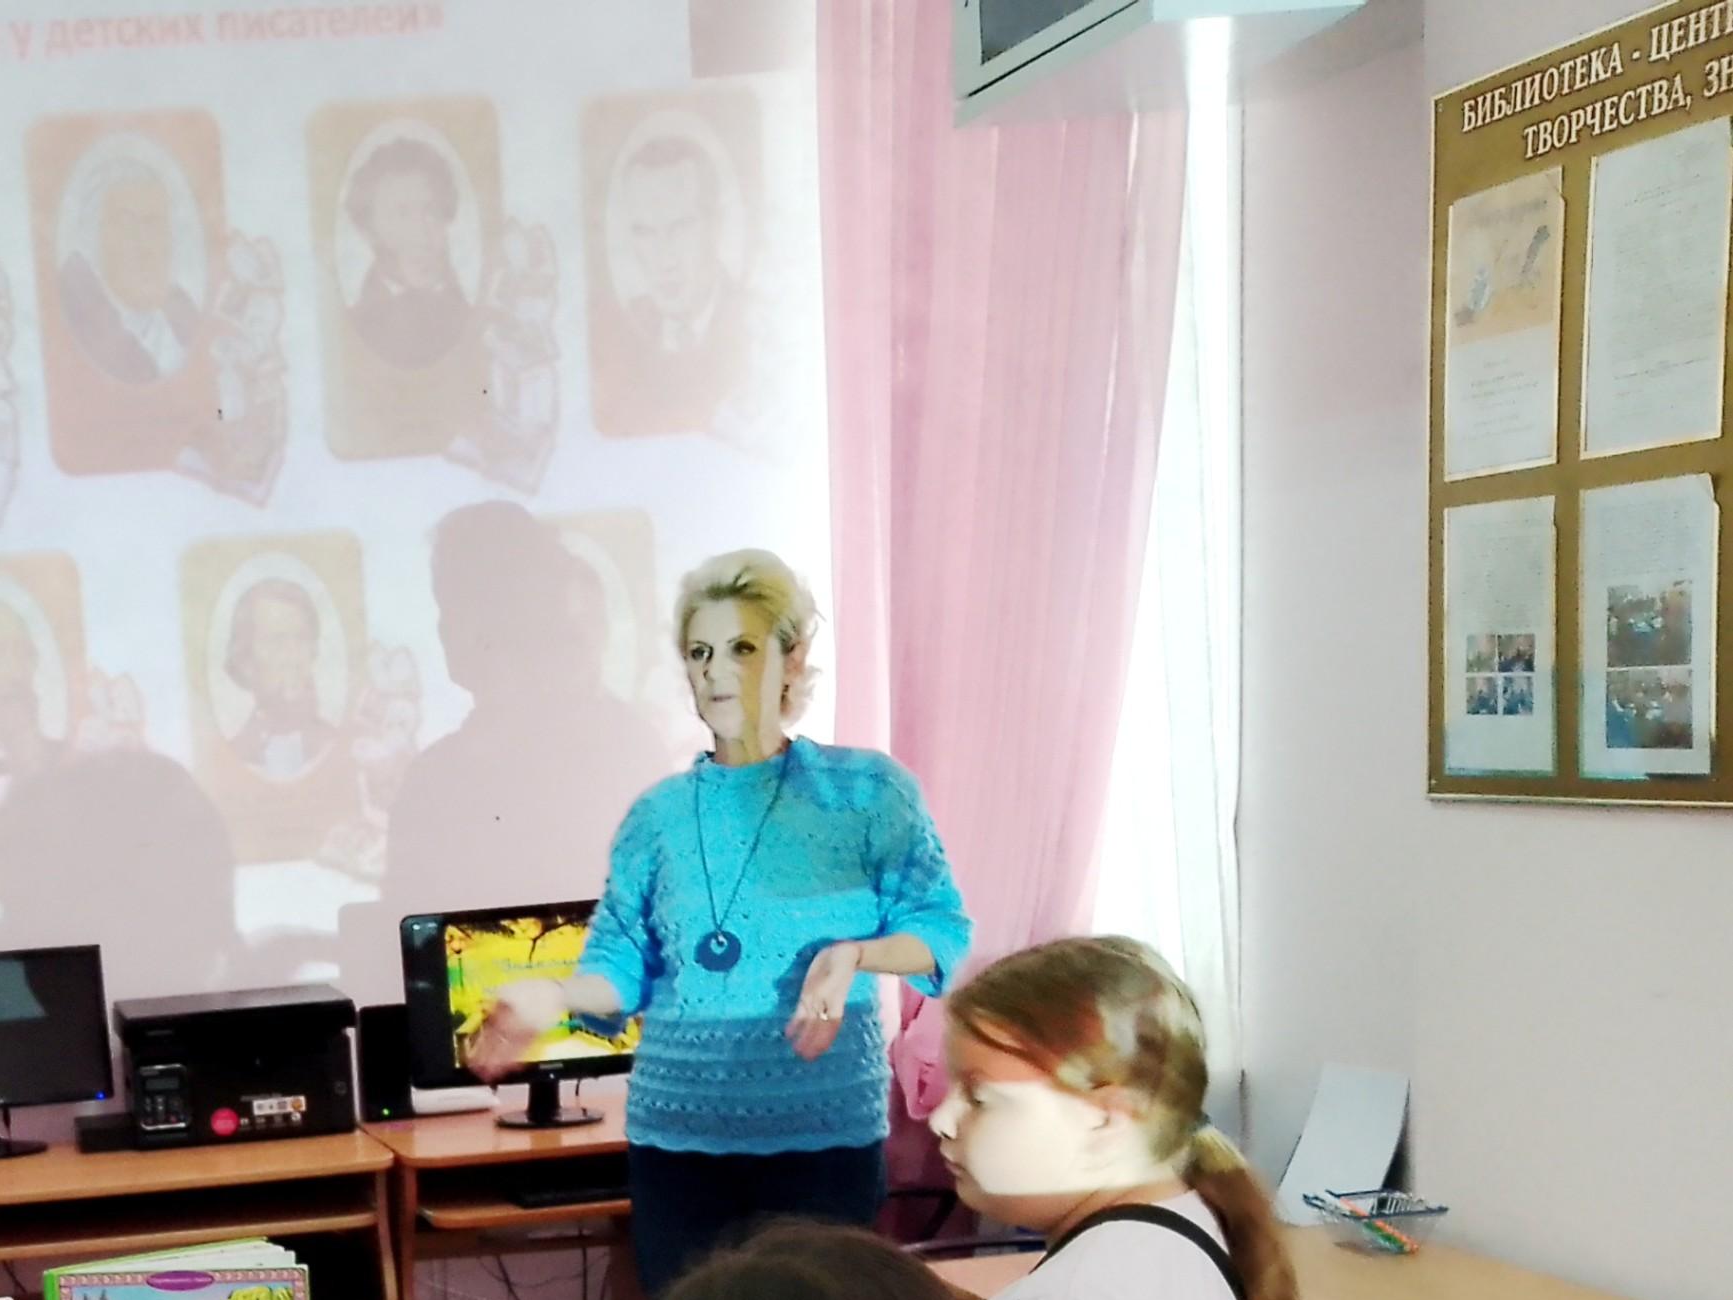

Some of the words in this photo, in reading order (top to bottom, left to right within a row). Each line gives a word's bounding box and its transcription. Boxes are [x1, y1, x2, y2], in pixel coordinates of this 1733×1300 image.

[9, 19, 34, 61] у
[44, 10, 205, 58] детских
[1462, 43, 1623, 132] БИБЛИОТЕКА
[1524, 73, 1692, 159] ТВОРЧЕСТВА,
